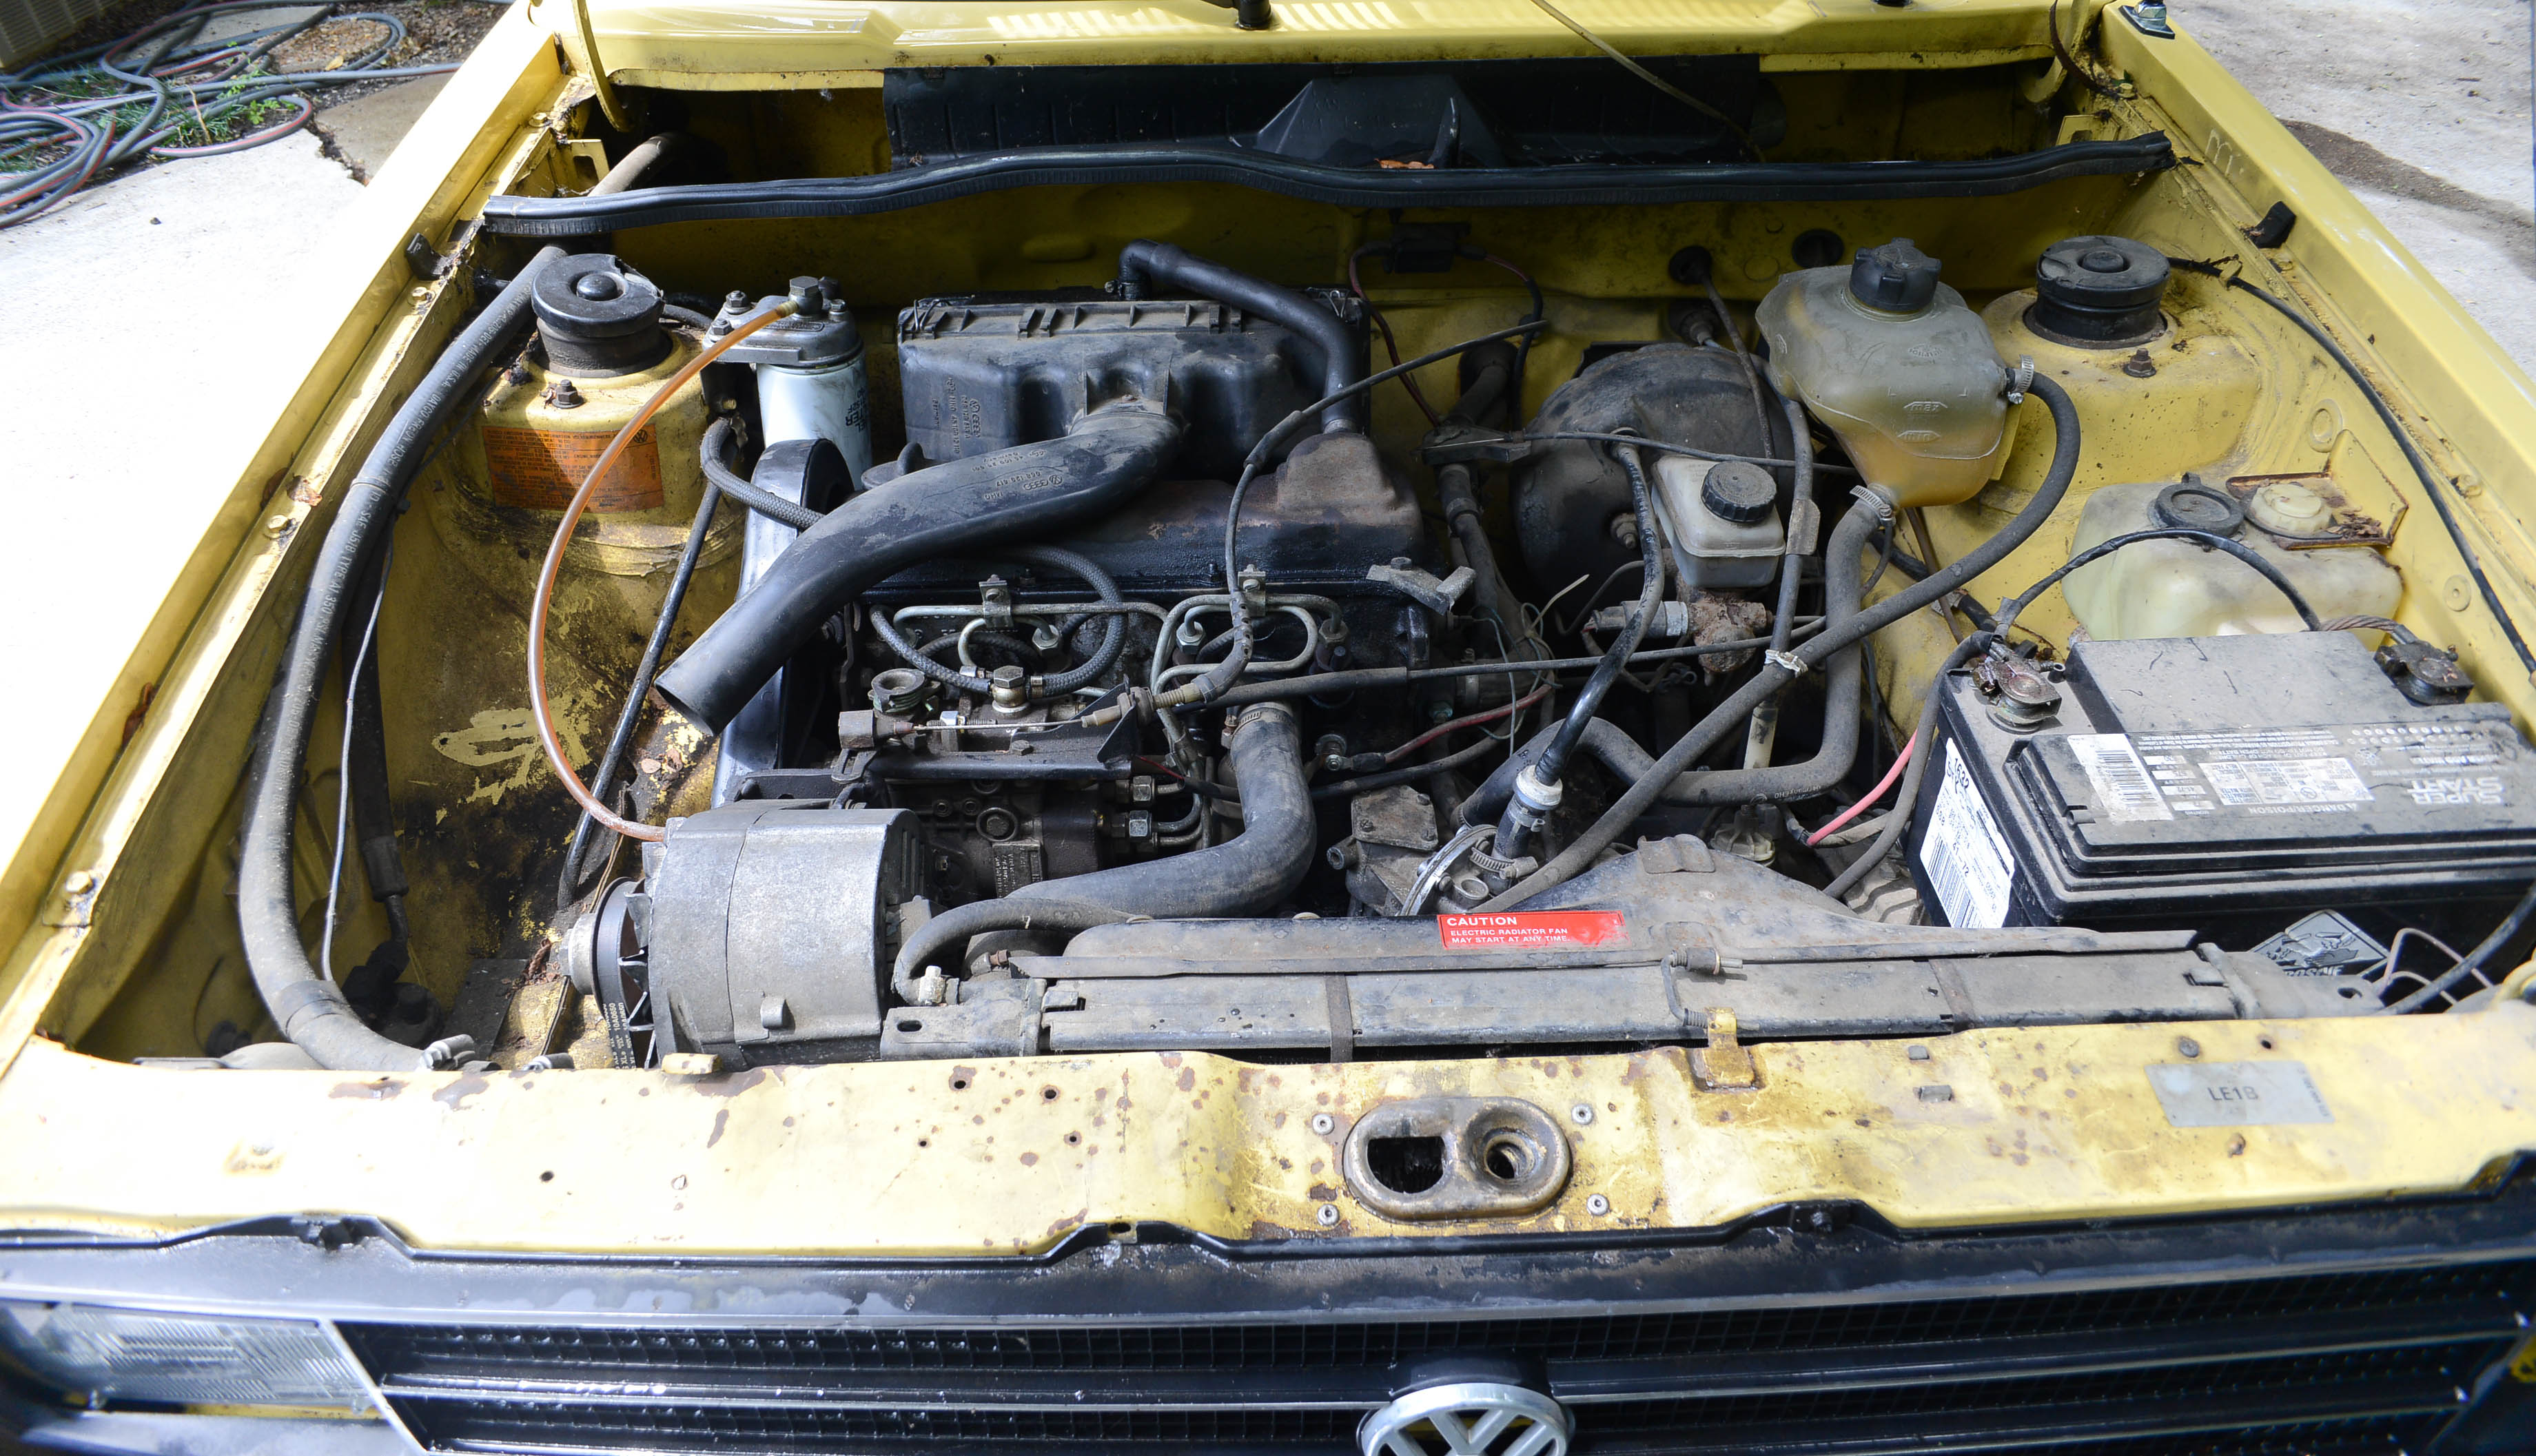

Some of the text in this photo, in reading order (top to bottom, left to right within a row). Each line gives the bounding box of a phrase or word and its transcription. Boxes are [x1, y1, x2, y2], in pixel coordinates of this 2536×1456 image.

[2412, 791, 2502, 805] SUPER
[1447, 917, 1517, 926] CAUTION
[609, 1003, 621, 1031] 10A0650
[2207, 1085, 2259, 1102] LE1B
